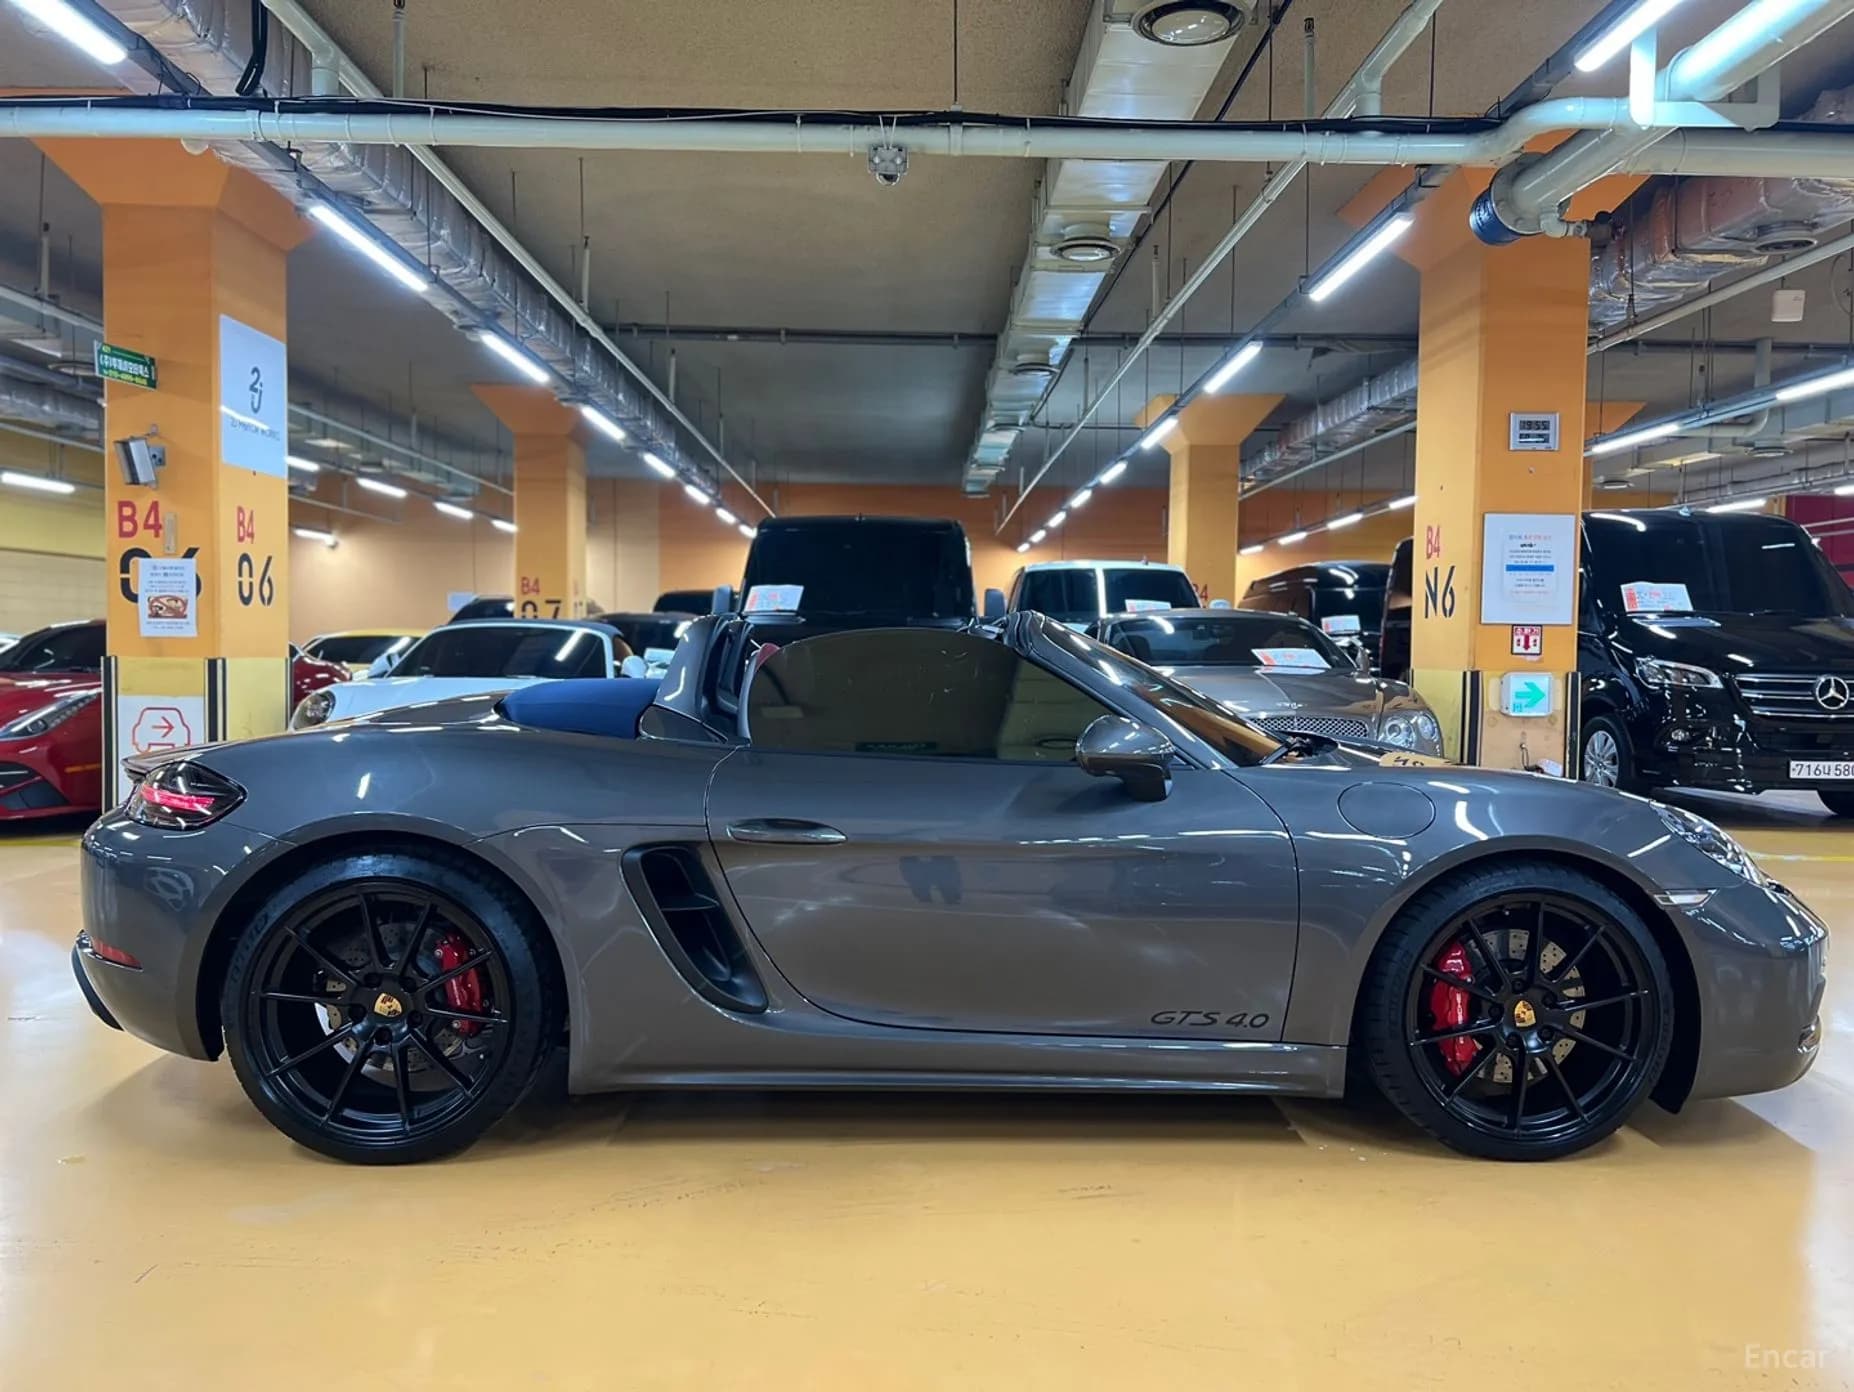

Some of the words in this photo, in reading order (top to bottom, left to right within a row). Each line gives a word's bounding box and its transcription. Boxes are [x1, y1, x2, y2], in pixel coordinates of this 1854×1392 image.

[118, 500, 163, 538] B4
[237, 506, 255, 544] B4
[1426, 525, 1441, 560] B4
[238, 553, 274, 606] 06
[521, 576, 540, 595] B4
[1425, 565, 1456, 618] N6
[1150, 1010, 1220, 1026] GTS
[1225, 1012, 1270, 1028] 4.0
